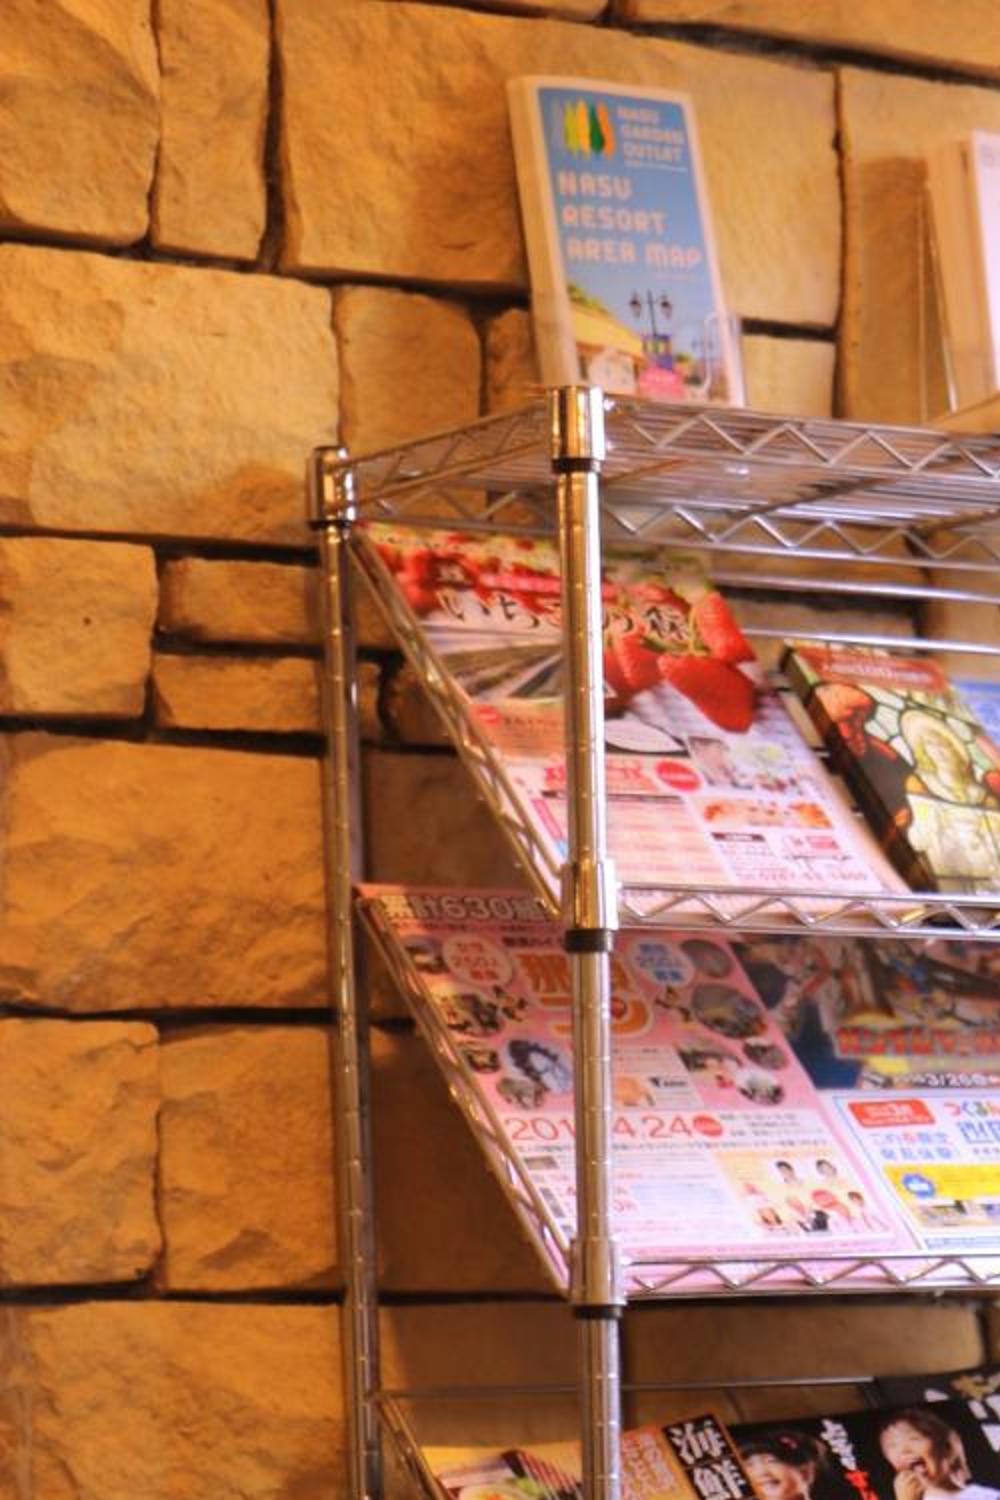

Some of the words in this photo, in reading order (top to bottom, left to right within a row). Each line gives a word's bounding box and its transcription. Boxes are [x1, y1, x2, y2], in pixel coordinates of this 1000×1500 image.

[558, 170, 633, 200] NASU
[561, 204, 670, 235] RESORT
[567, 238, 637, 264] AREA
[644, 242, 702, 270] MAP
